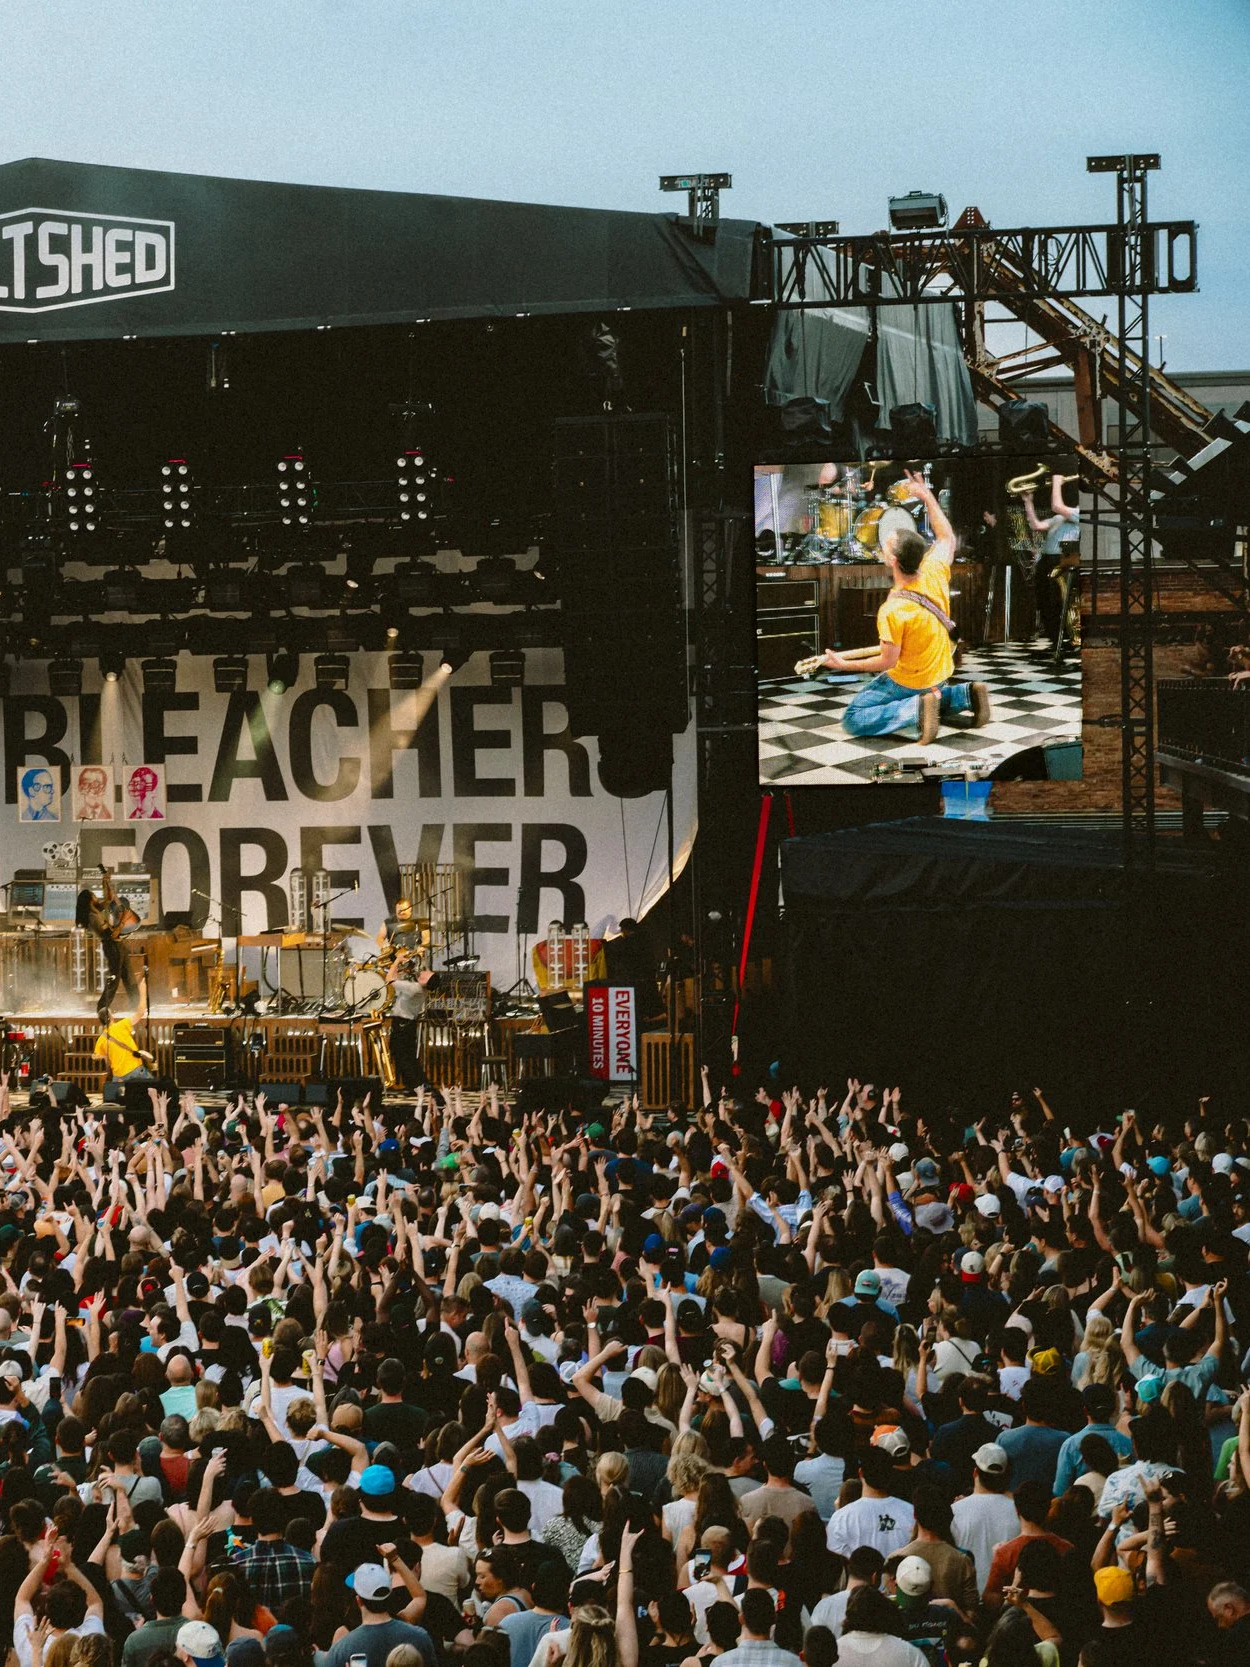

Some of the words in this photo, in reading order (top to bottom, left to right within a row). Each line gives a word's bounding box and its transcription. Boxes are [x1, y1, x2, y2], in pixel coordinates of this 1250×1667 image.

[36, 221, 167, 299] SHED
[4, 684, 667, 804] BLEACHER
[592, 998, 604, 1012] 10
[592, 1015, 604, 1069] MINUTES
[615, 990, 631, 1074] EVERYONE
